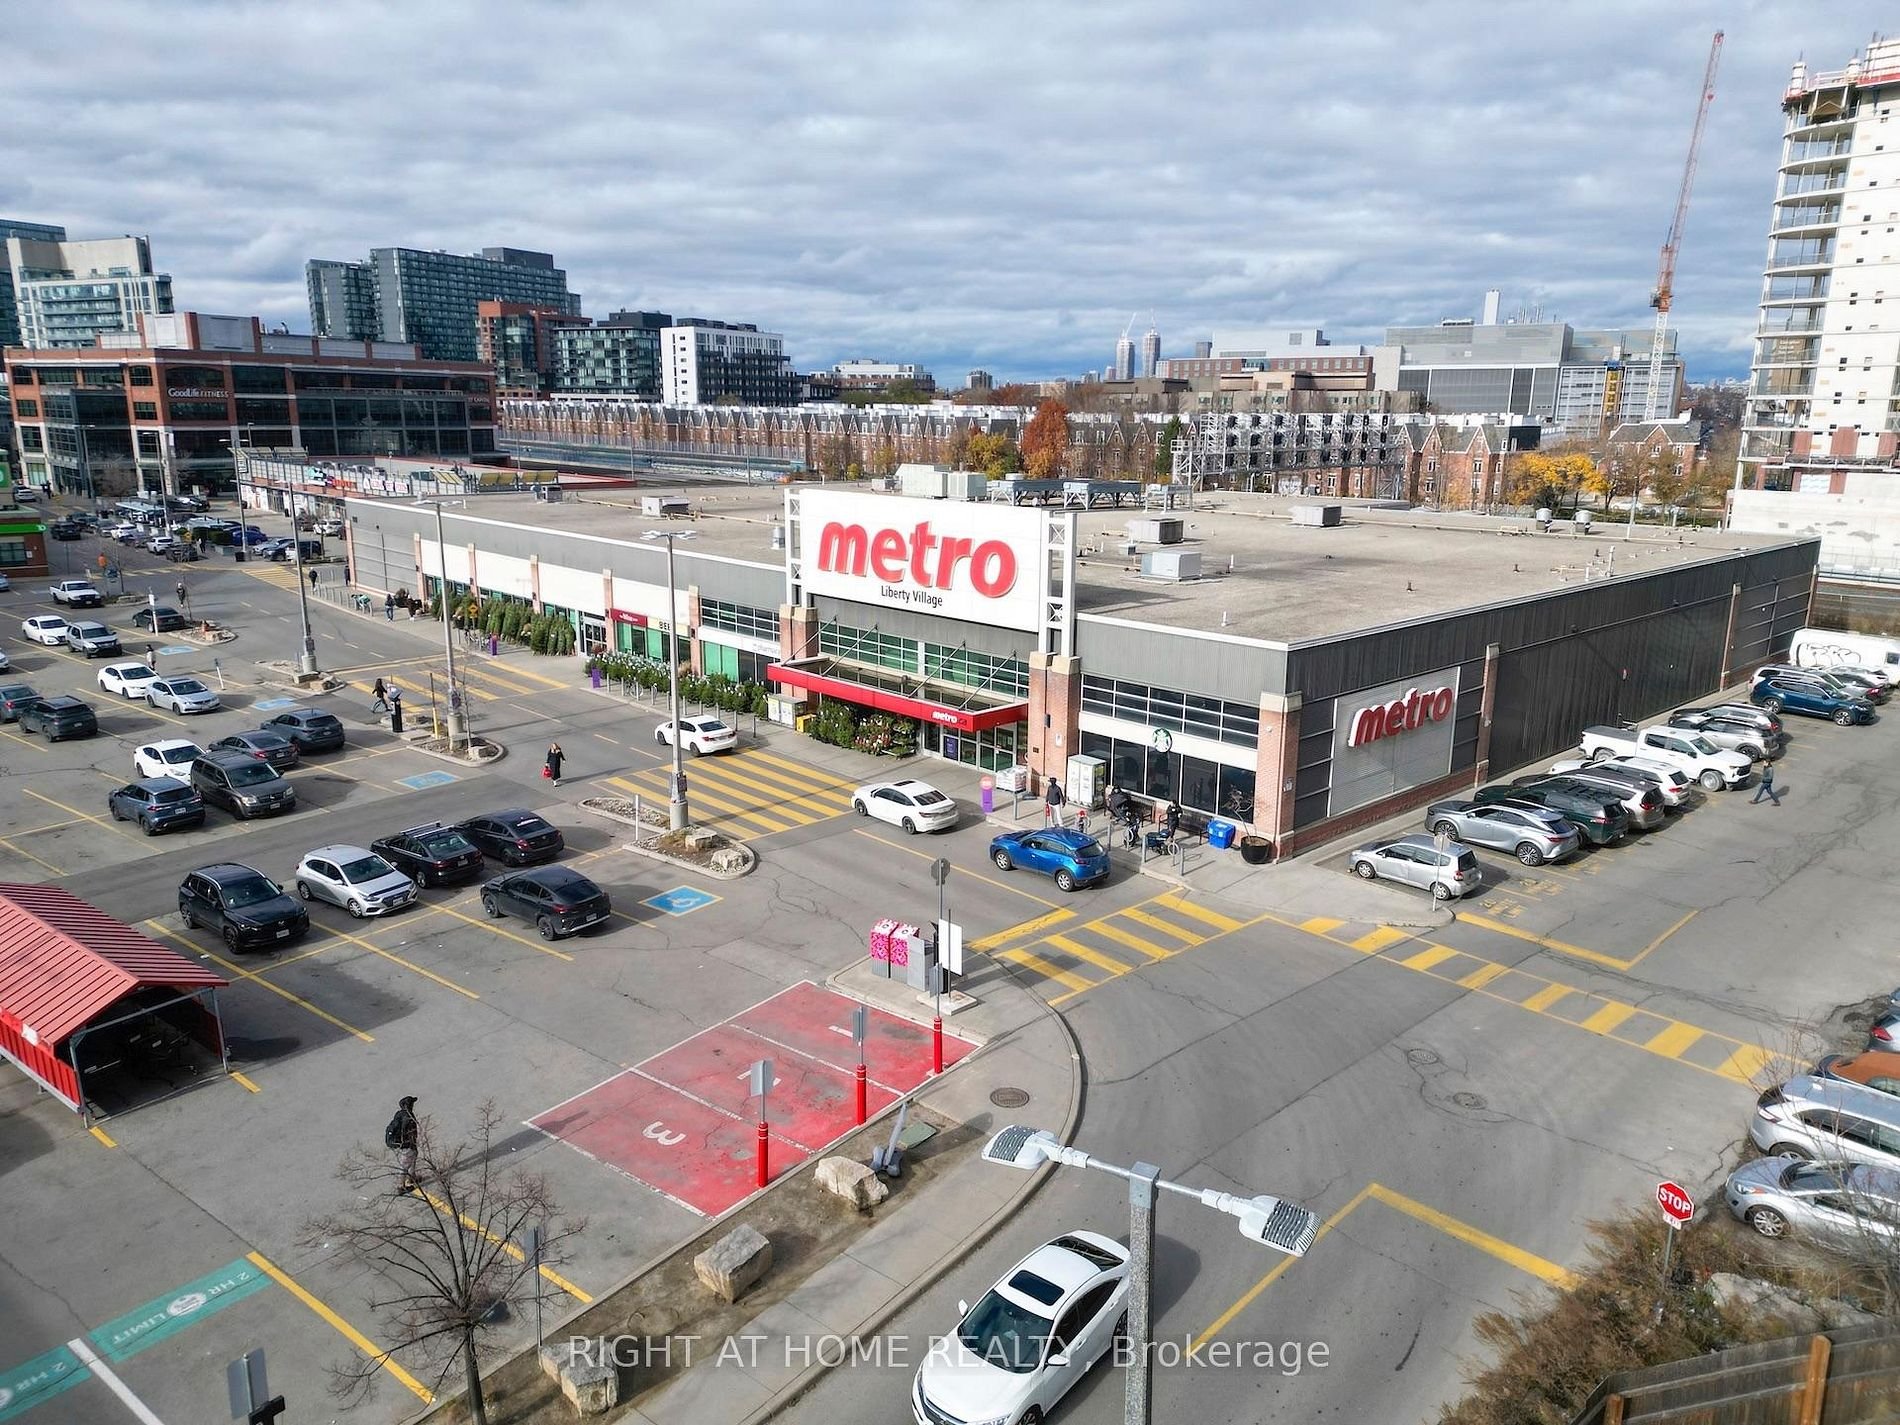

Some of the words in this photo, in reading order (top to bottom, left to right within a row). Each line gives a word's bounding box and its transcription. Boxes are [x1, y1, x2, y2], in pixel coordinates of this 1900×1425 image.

[818, 521, 1018, 598] metro
[880, 585, 911, 604] Liberty
[912, 589, 943, 609] Village
[1348, 687, 1453, 746] metro
[642, 1121, 687, 1146] 3
[1660, 1187, 1691, 1213] STOP
[236, 1271, 250, 1281] 2
[113, 1313, 166, 1344] LIMIT
